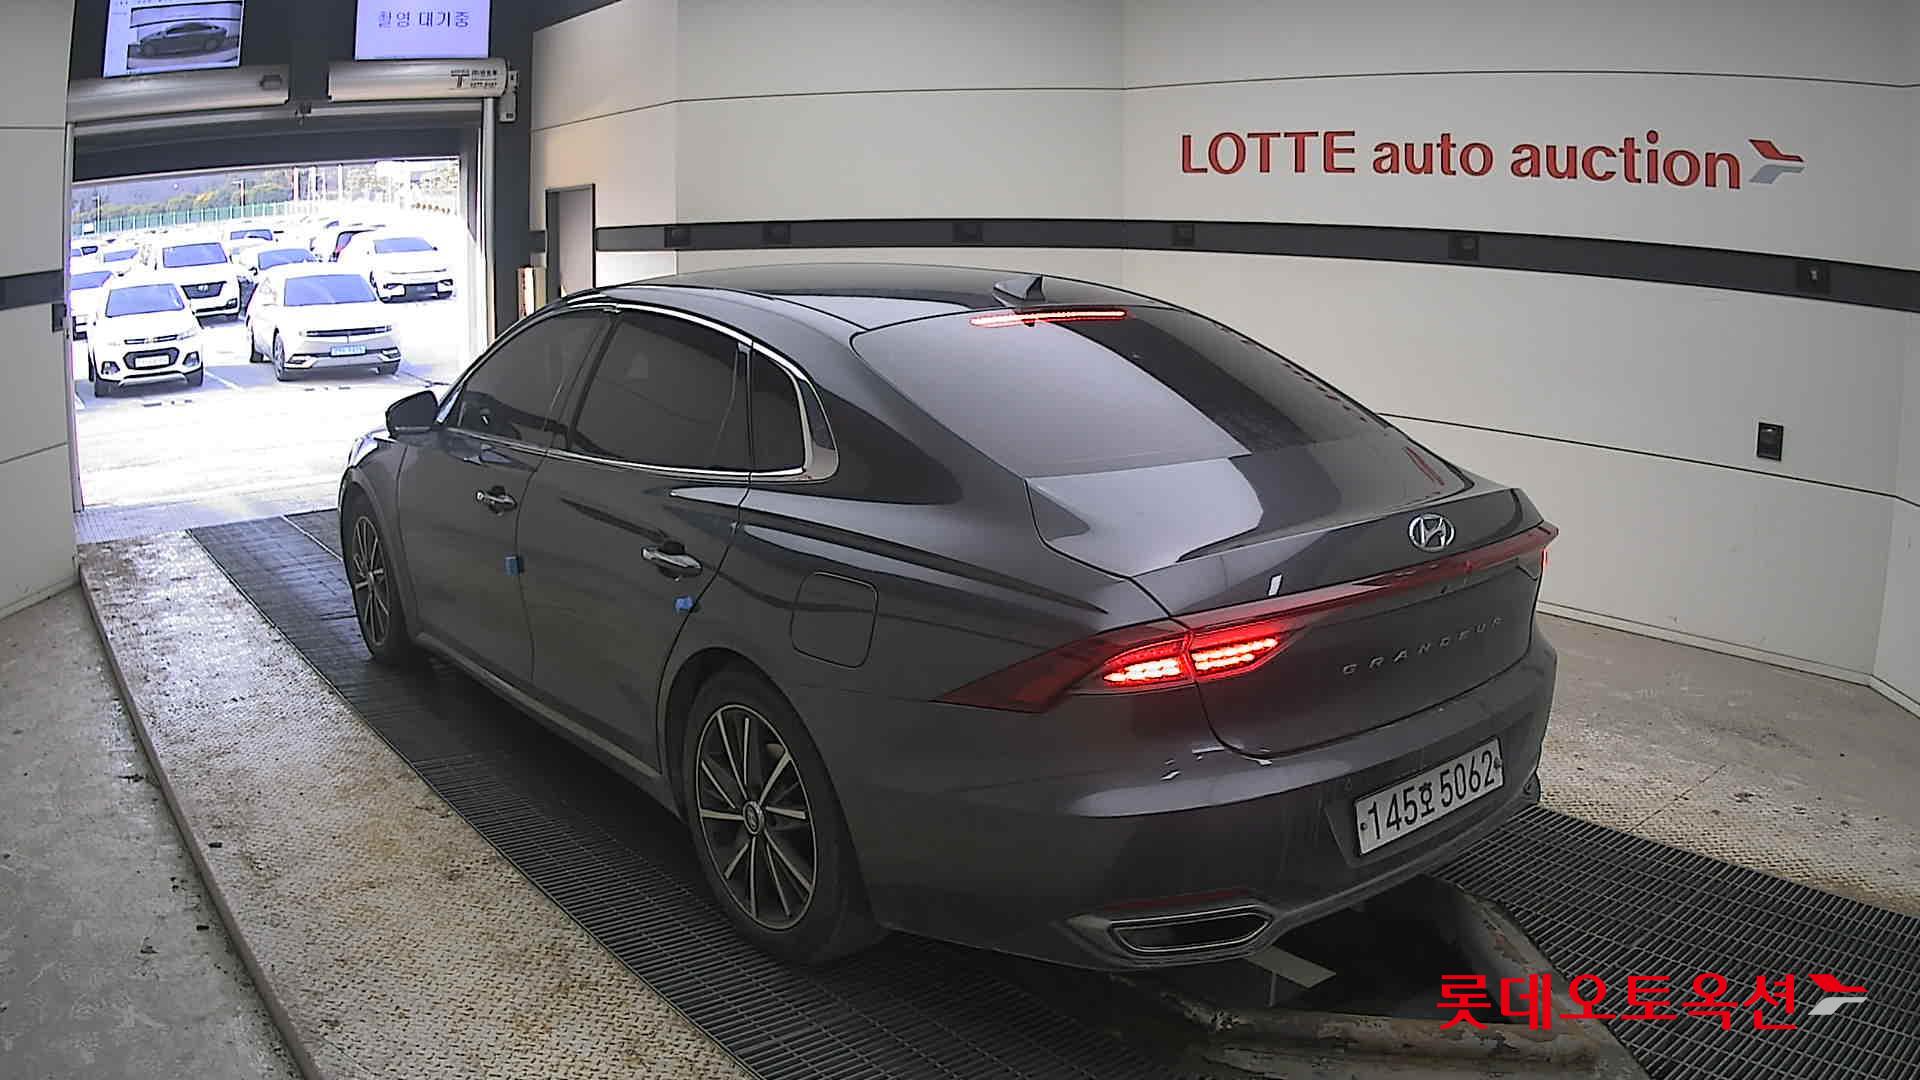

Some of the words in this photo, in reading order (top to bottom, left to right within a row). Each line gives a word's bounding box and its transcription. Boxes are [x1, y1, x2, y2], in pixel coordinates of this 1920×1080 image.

[419, 10, 469, 28] 대기중
[1181, 130, 1356, 174] LOTTE
[1373, 132, 1494, 177] auto
[1511, 129, 1741, 190] auction
[1342, 615, 1505, 676] GRANDEUR
[1366, 781, 1435, 841] 145호
[1440, 750, 1497, 808] 5062
